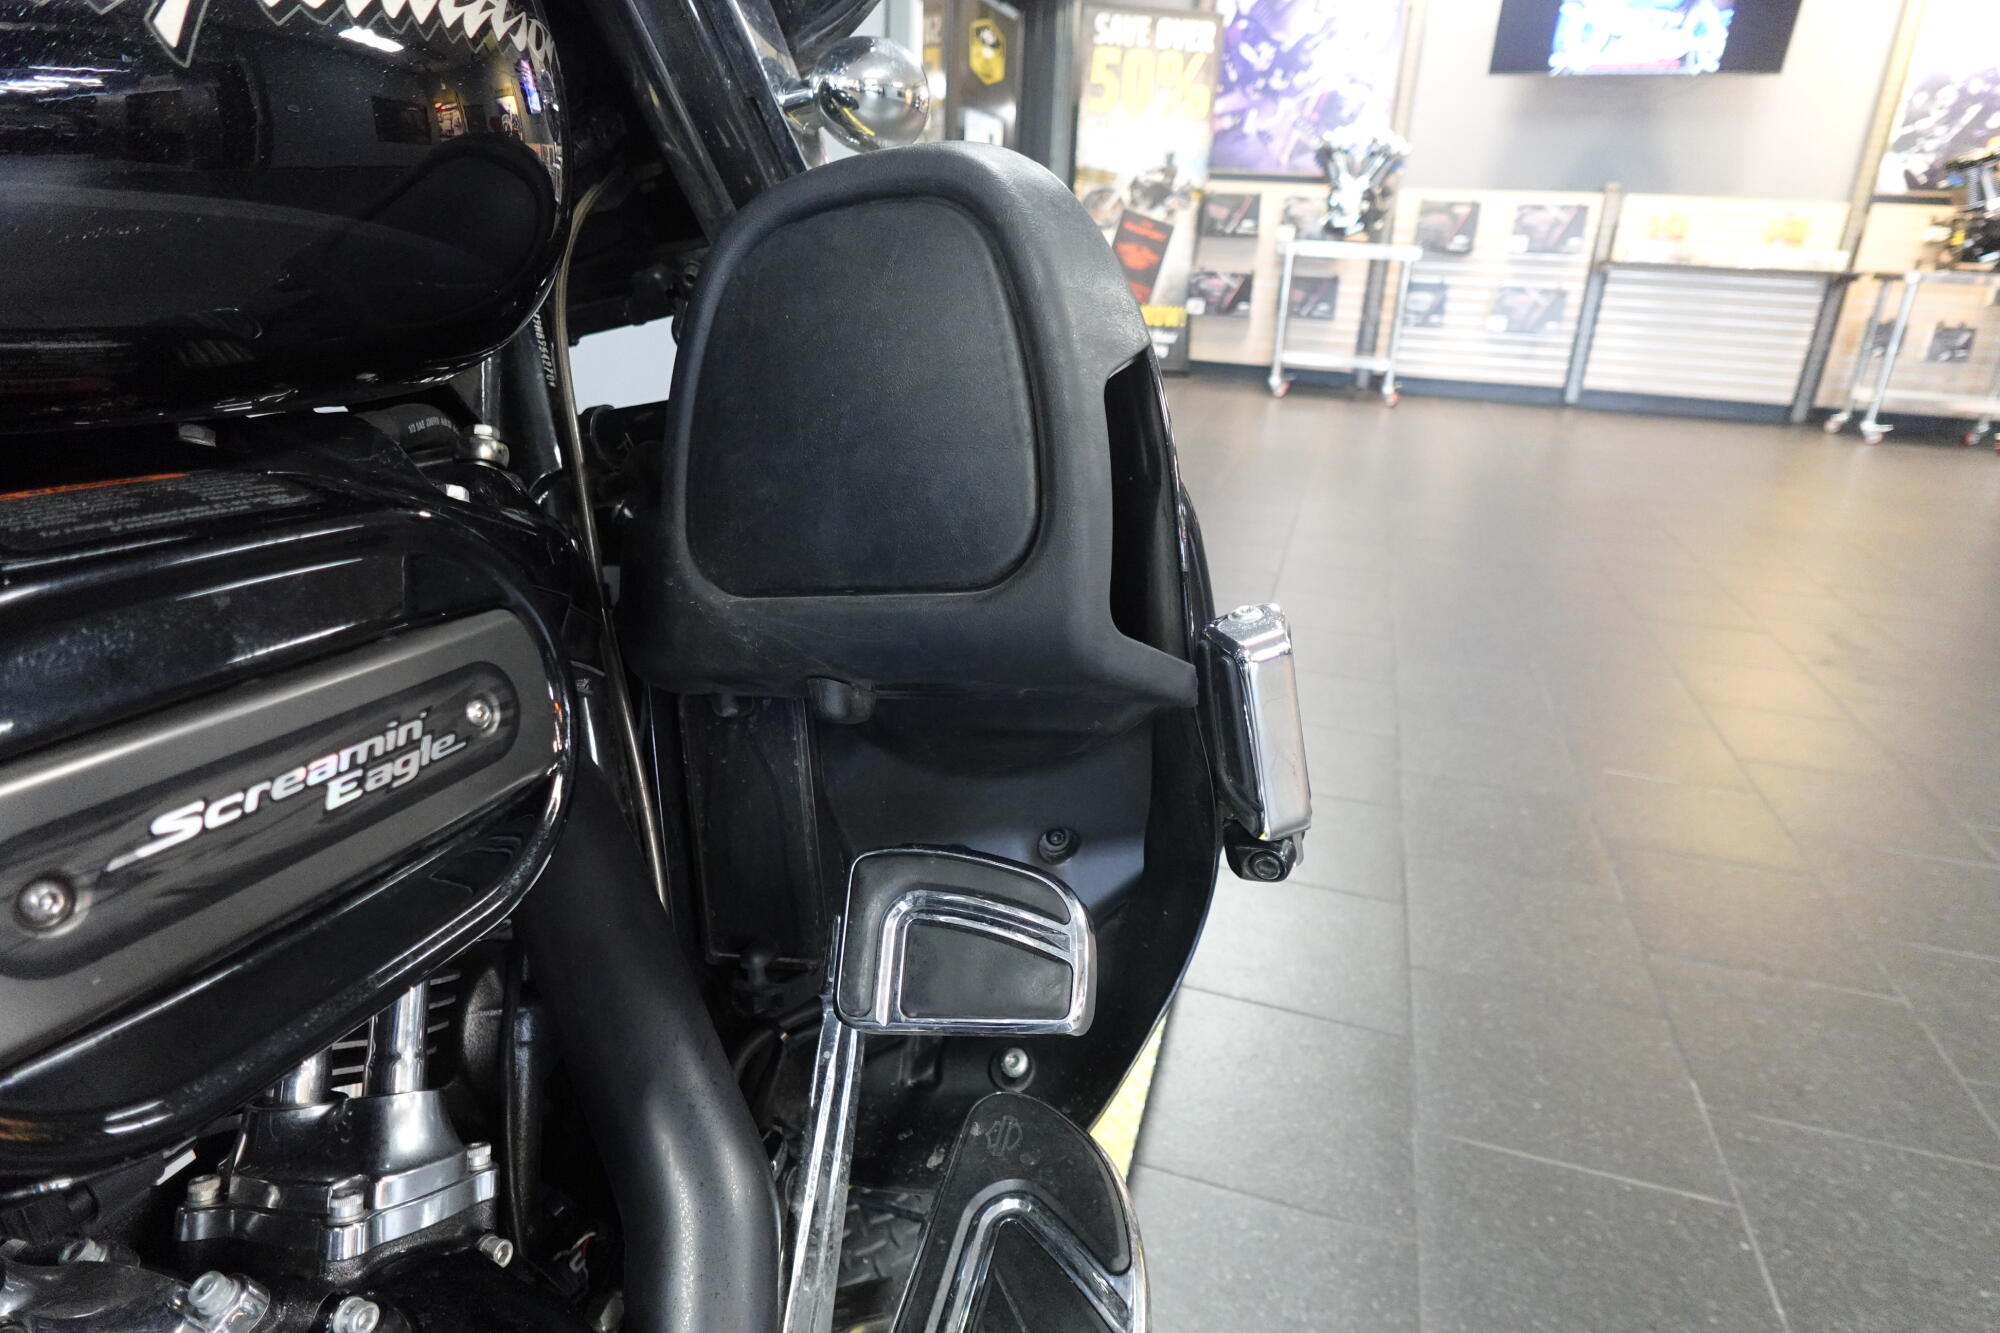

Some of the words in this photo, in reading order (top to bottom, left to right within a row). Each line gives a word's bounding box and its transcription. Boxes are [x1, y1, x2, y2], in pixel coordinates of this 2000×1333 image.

[1093, 12, 1152, 48] SAVE
[1155, 16, 1216, 53] OVER
[1088, 45, 1211, 120] 50%
[106, 711, 428, 872] Screamin'
[324, 733, 467, 811] Eagle
